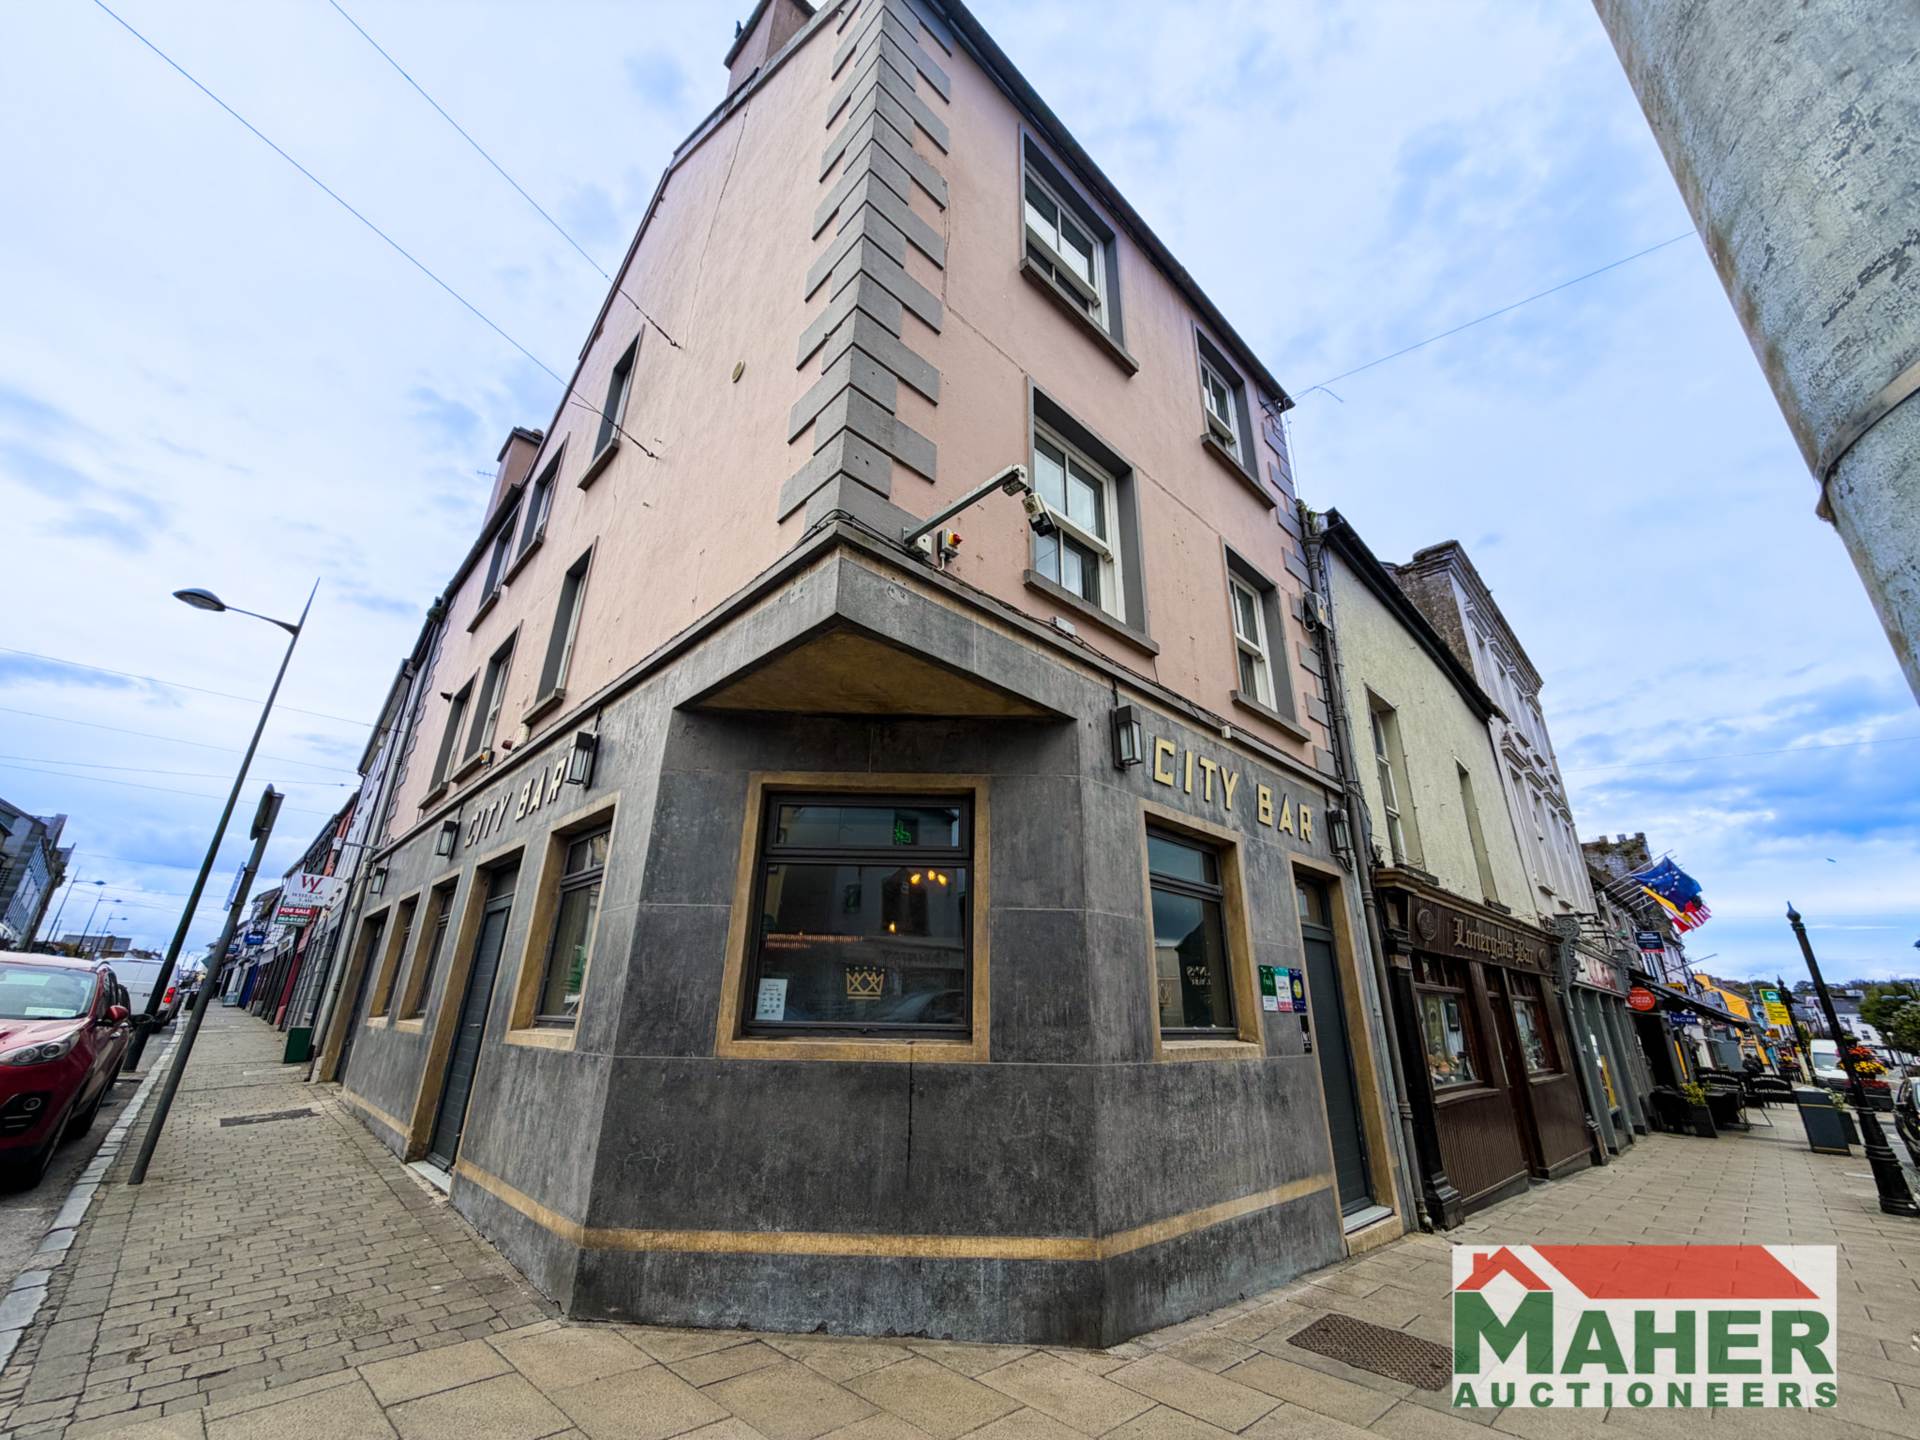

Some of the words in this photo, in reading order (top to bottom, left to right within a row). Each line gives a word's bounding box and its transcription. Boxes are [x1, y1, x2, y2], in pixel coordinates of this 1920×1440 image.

[464, 791, 513, 849] CITY
[514, 756, 569, 823] BAR
[1153, 735, 1239, 811] CITY
[1256, 783, 1312, 843] BAR
